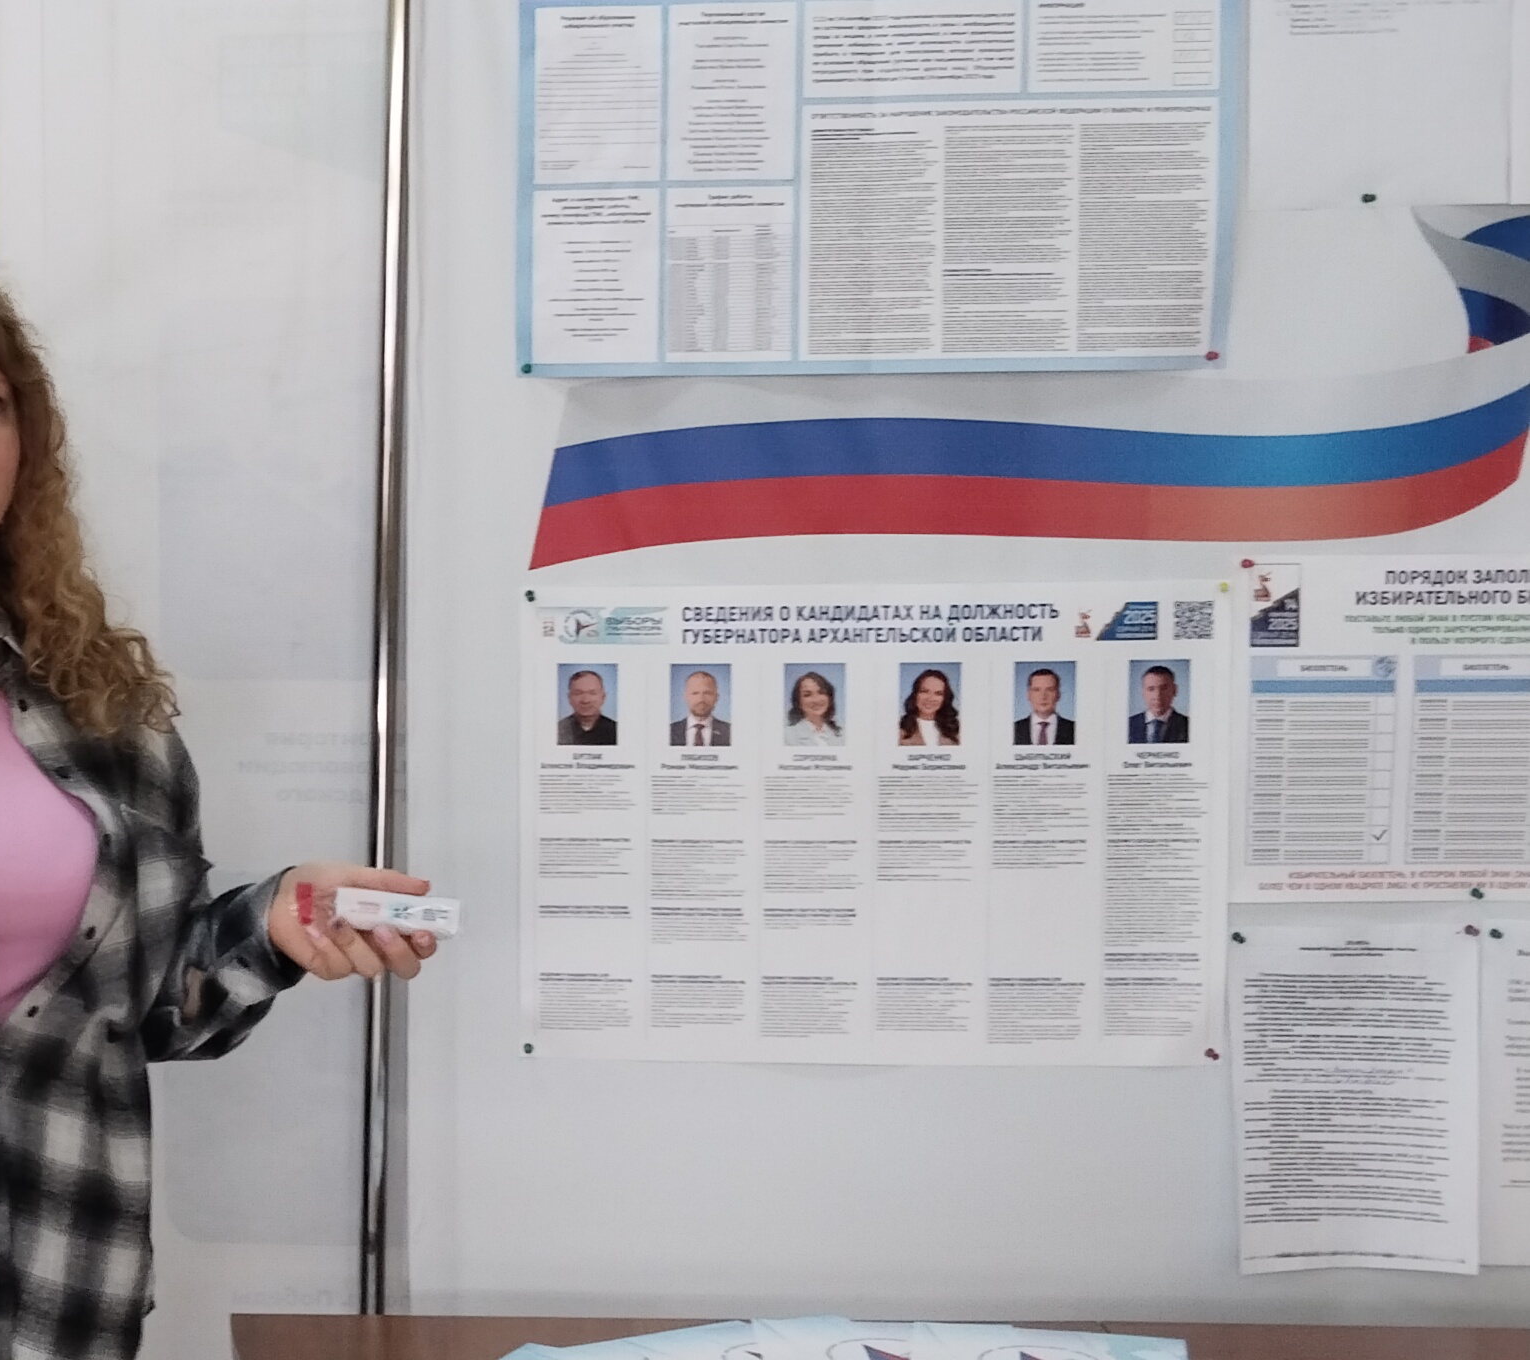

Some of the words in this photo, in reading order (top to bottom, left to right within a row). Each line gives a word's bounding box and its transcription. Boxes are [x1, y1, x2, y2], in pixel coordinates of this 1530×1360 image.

[1385, 570, 1468, 587] ПОРЯДОК
[1355, 590, 1512, 606] ИЗБИРАТЕЛЬНОГО
[682, 606, 774, 623] СВЕДЕНИЯ
[779, 606, 791, 621] О
[796, 605, 914, 623] КАНДИДАТАХ
[920, 605, 942, 621] НА
[948, 603, 1060, 622] ДОЛЖНОСТЬ
[682, 628, 802, 644] ГУБЕРНАТОРА
[807, 624, 956, 644] АРХАНГЕЛЬСКОЙ
[962, 626, 1043, 643] ОБЛАСТИ
